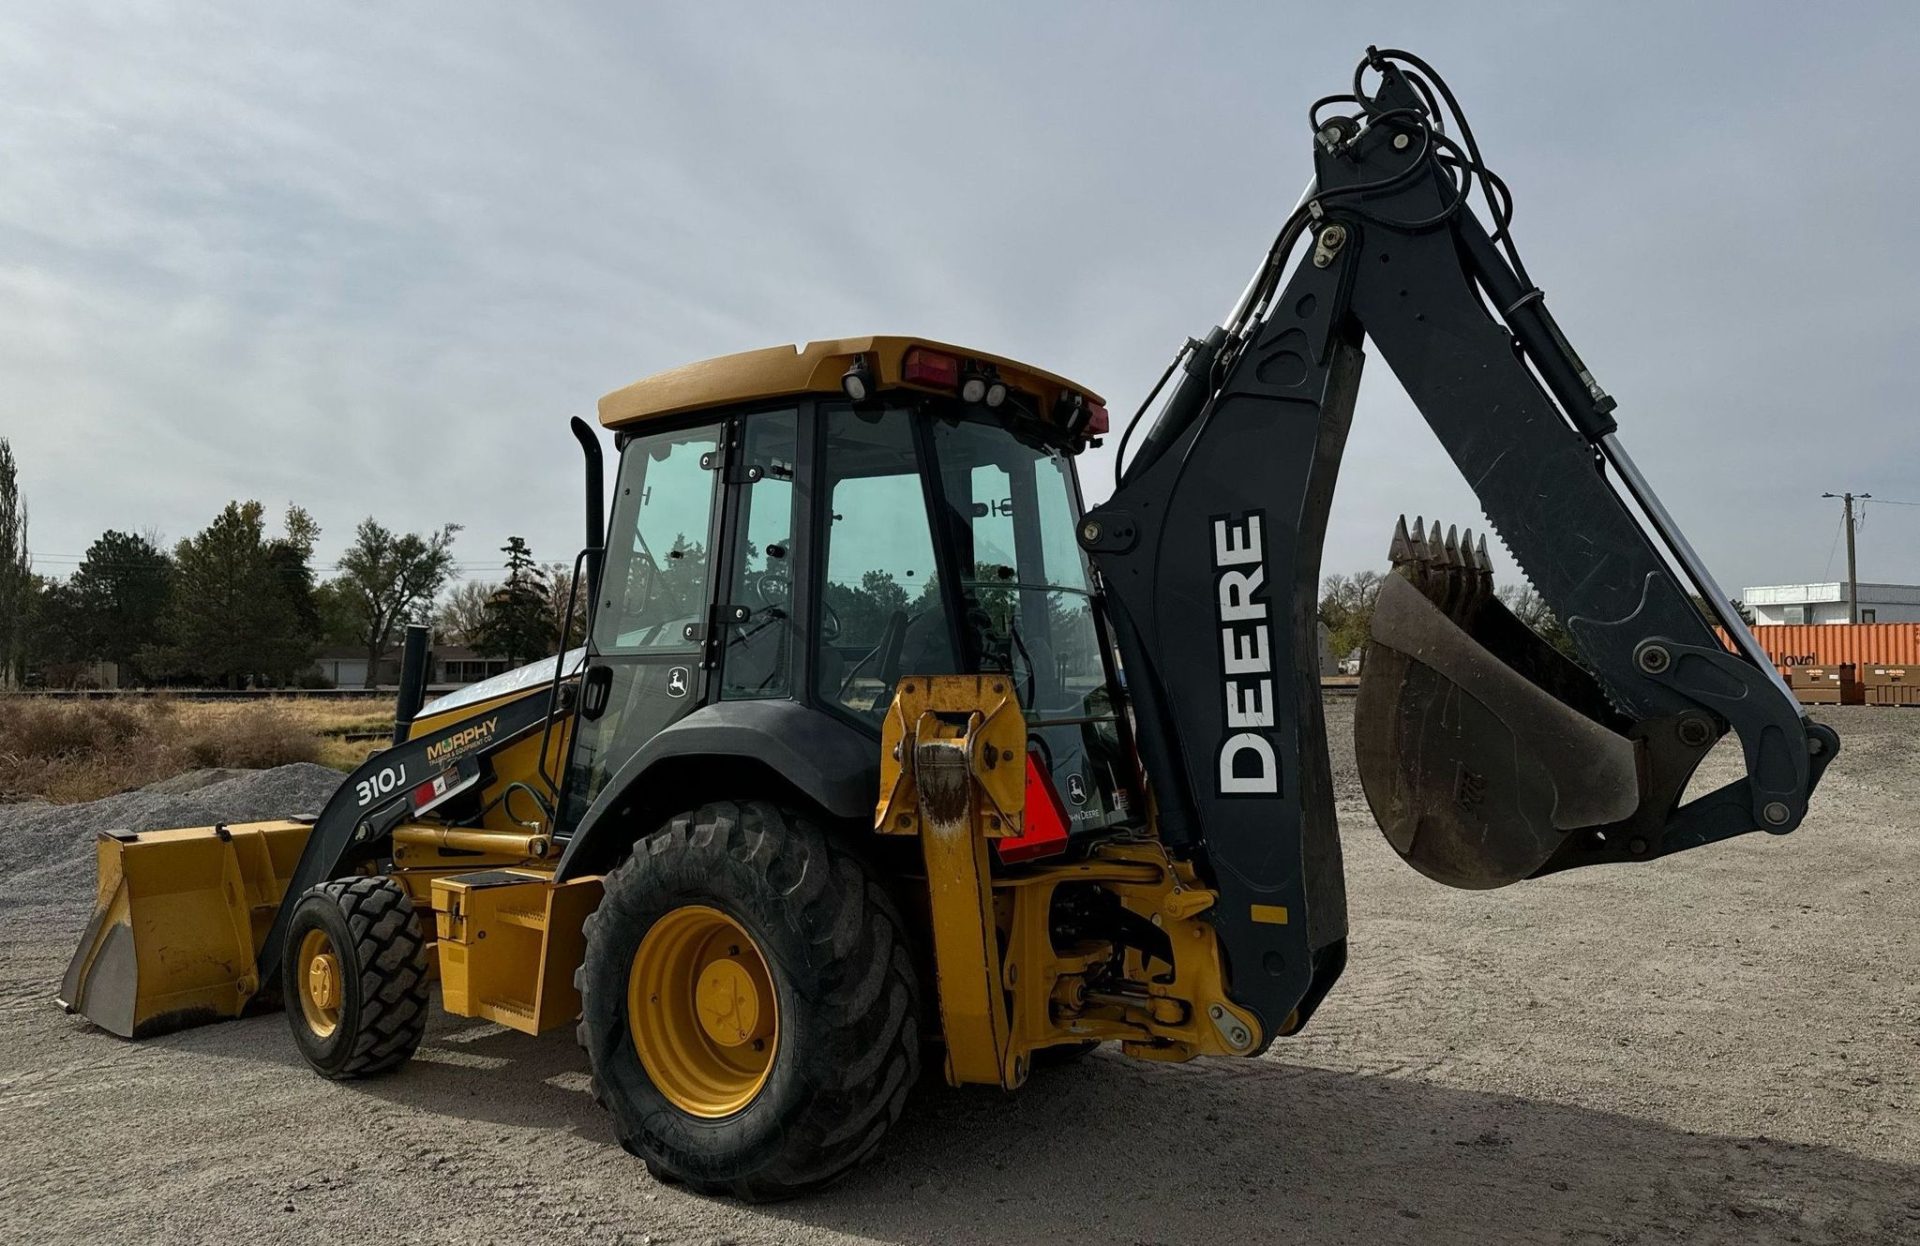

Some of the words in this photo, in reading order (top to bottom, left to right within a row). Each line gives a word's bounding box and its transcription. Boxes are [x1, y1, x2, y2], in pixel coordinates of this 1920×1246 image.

[1213, 515, 1278, 793] DEERE
[427, 716, 498, 761] MURPHY
[356, 764, 406, 806] 310J
